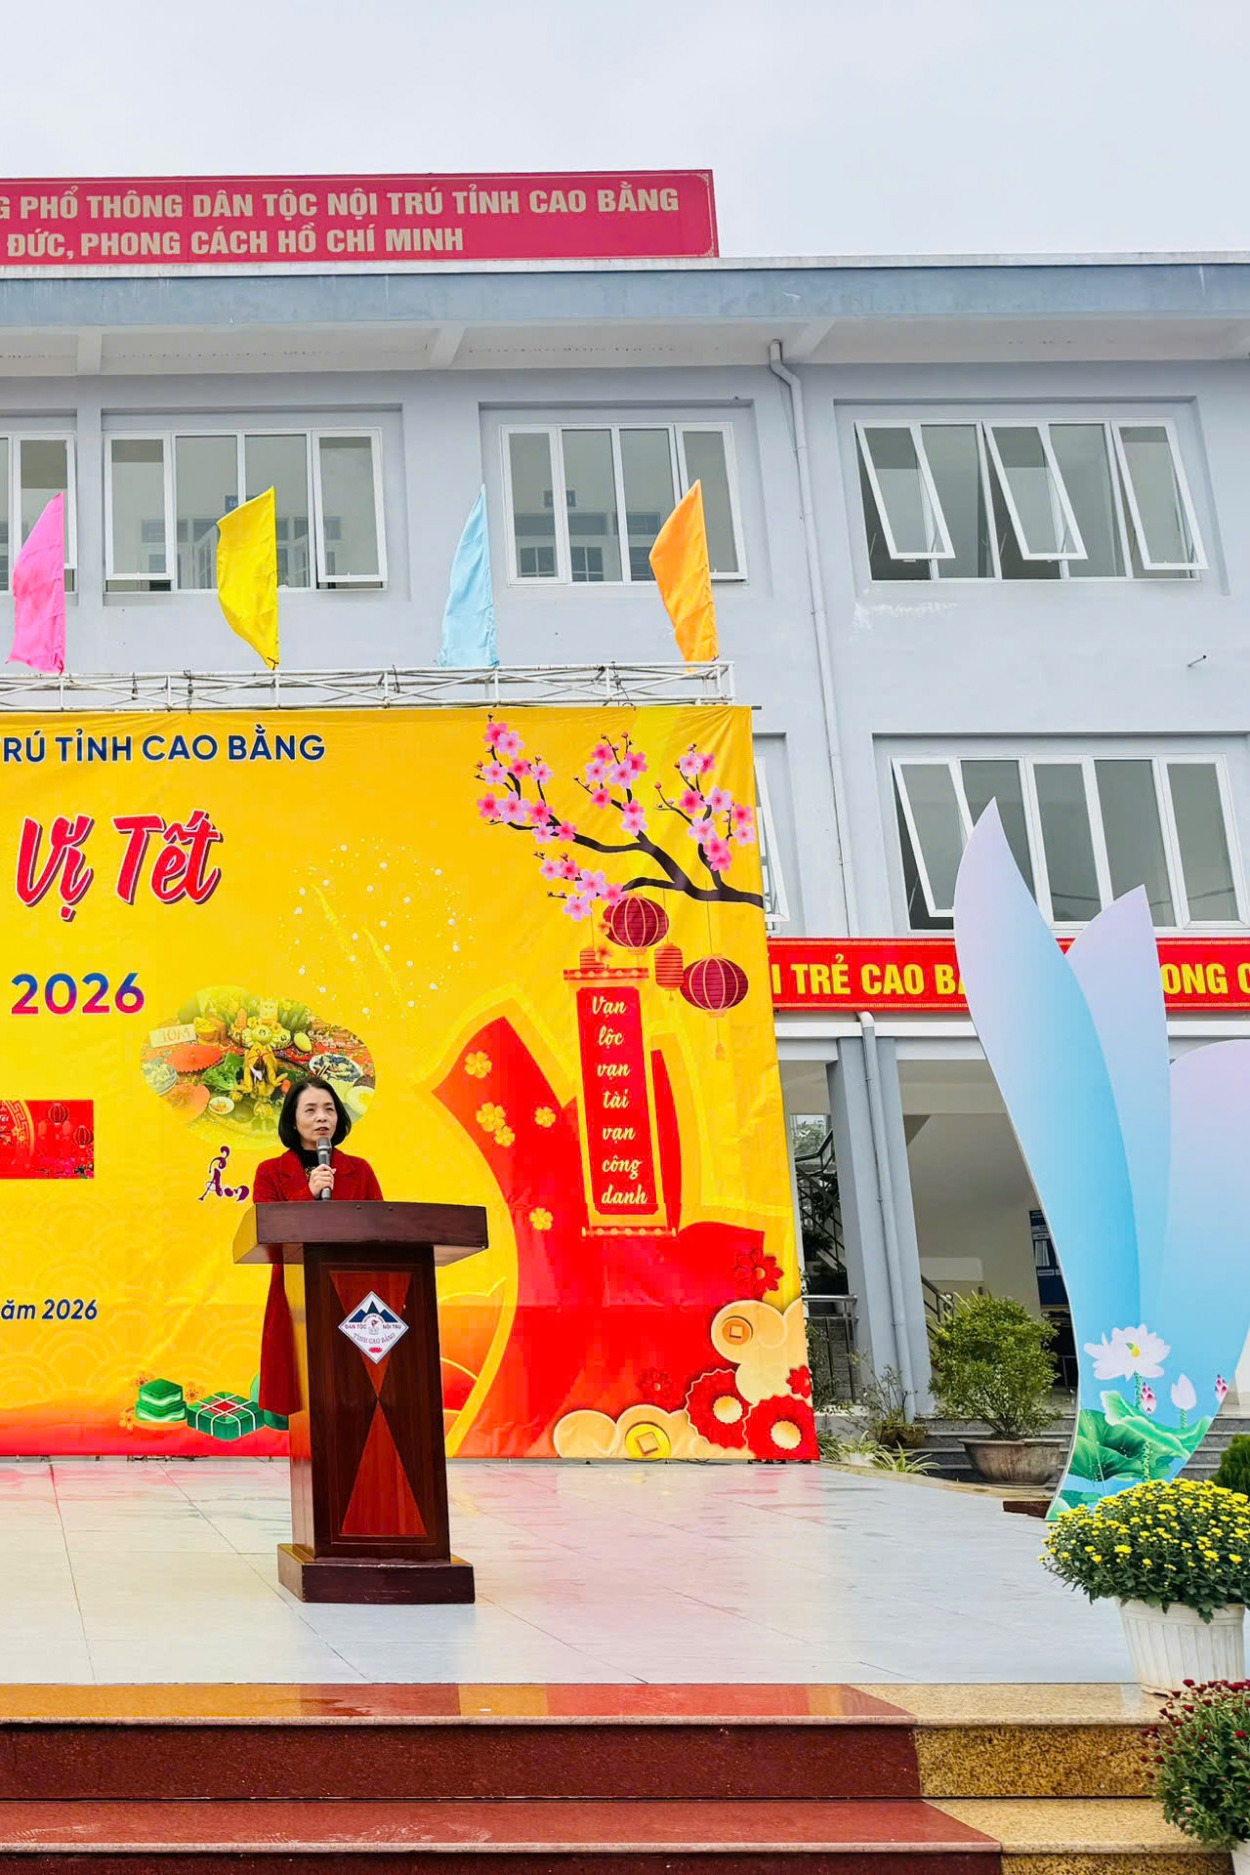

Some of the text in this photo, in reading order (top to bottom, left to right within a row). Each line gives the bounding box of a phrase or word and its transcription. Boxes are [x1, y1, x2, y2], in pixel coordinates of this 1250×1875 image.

[19, 185, 80, 220] PHỔ
[86, 189, 183, 218] THÔNG
[192, 189, 253, 218] DÂN
[262, 188, 318, 221] TỘC
[327, 187, 378, 220] NỘI
[386, 186, 443, 216] TRÚ
[452, 183, 519, 214] TỈNH
[529, 189, 587, 213] CAO
[597, 181, 680, 212] BẰNG
[6, 227, 74, 259] ĐỨC,
[80, 231, 181, 256] PHONG
[190, 225, 268, 255] CÁCH
[277, 221, 317, 253] HỒ
[326, 223, 376, 252] CHÍ
[385, 228, 463, 252] MINH
[54, 727, 132, 762] TỈNH
[141, 733, 219, 761] CAO
[226, 723, 326, 761] BẰNG
[15, 814, 95, 923] Vị
[111, 808, 224, 907] Tết
[10, 972, 146, 1015] 2026
[790, 953, 851, 995] TRẺ
[860, 963, 925, 995] CAO
[1160, 963, 1229, 995] ONG
[592, 995, 649, 1205] Vạn lộc vạn tài vạn công danh
[42, 1298, 98, 1320] 2026
